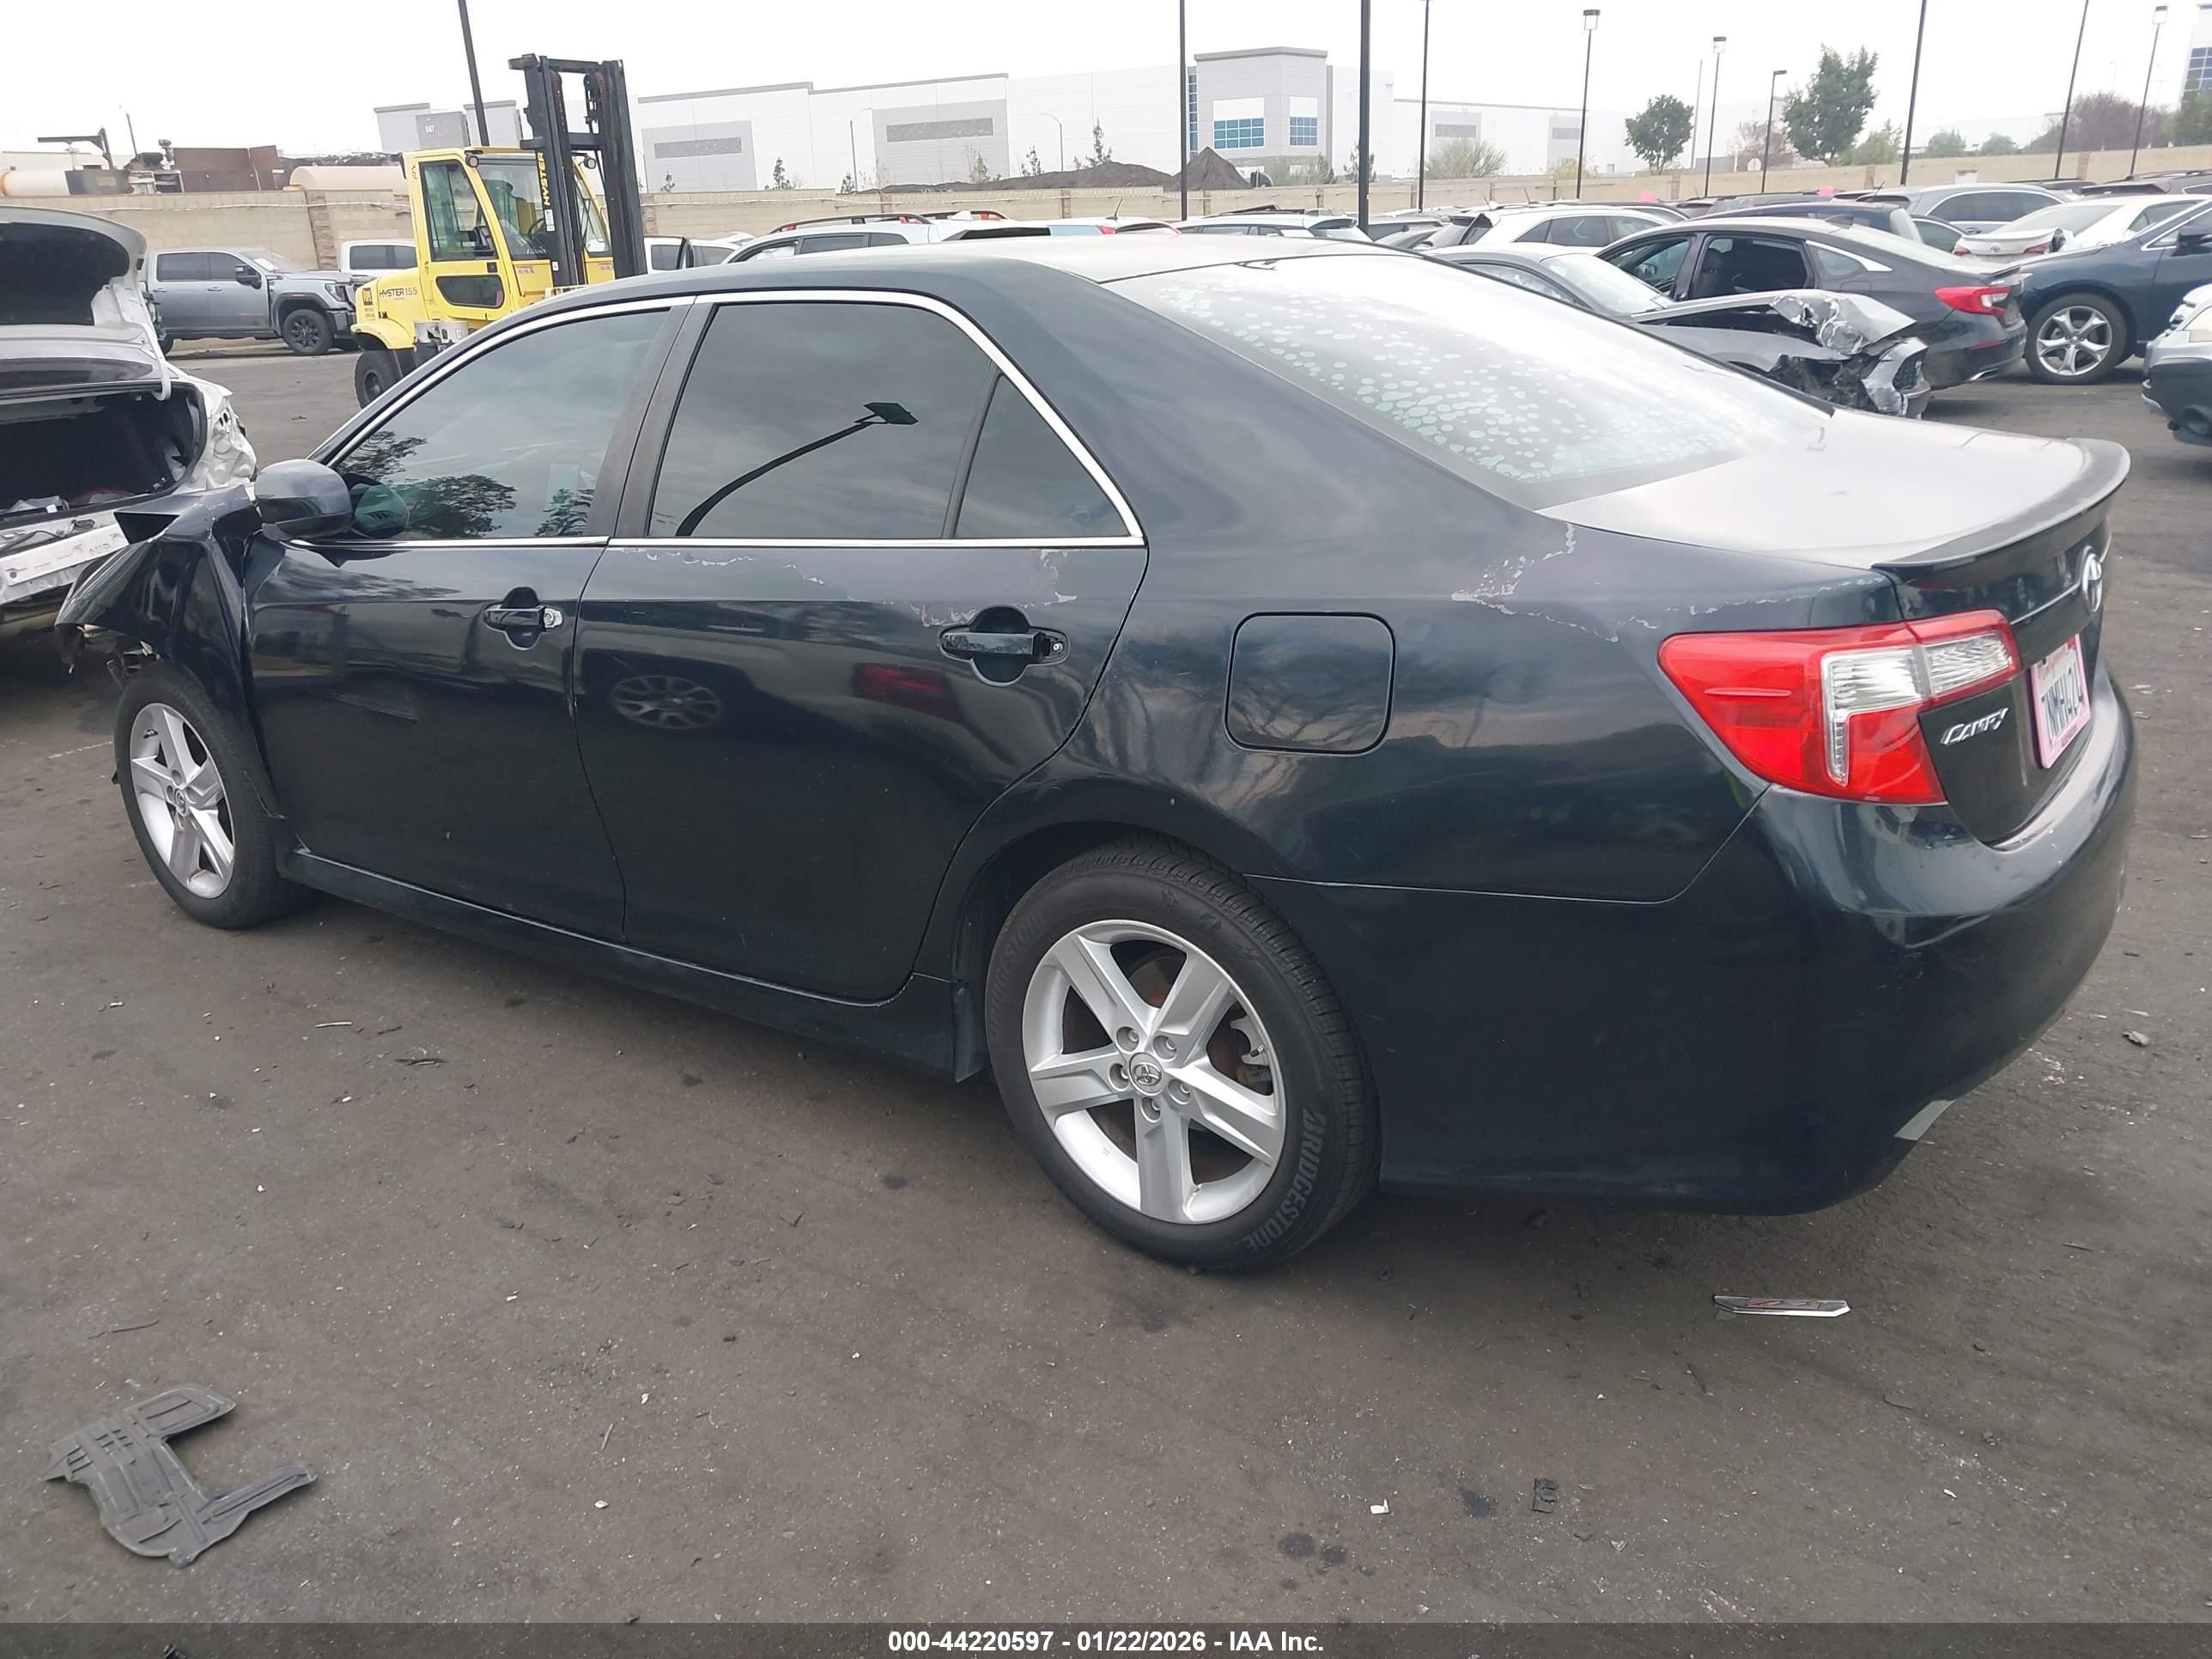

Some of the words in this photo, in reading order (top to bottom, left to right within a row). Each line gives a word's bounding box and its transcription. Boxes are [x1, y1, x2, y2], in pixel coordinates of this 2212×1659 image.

[538, 152, 550, 206] HYSTER
[379, 288, 404, 298] HYSTER
[404, 287, 418, 296] 155
[1243, 1107, 1327, 1253] BRIDGESTONE
